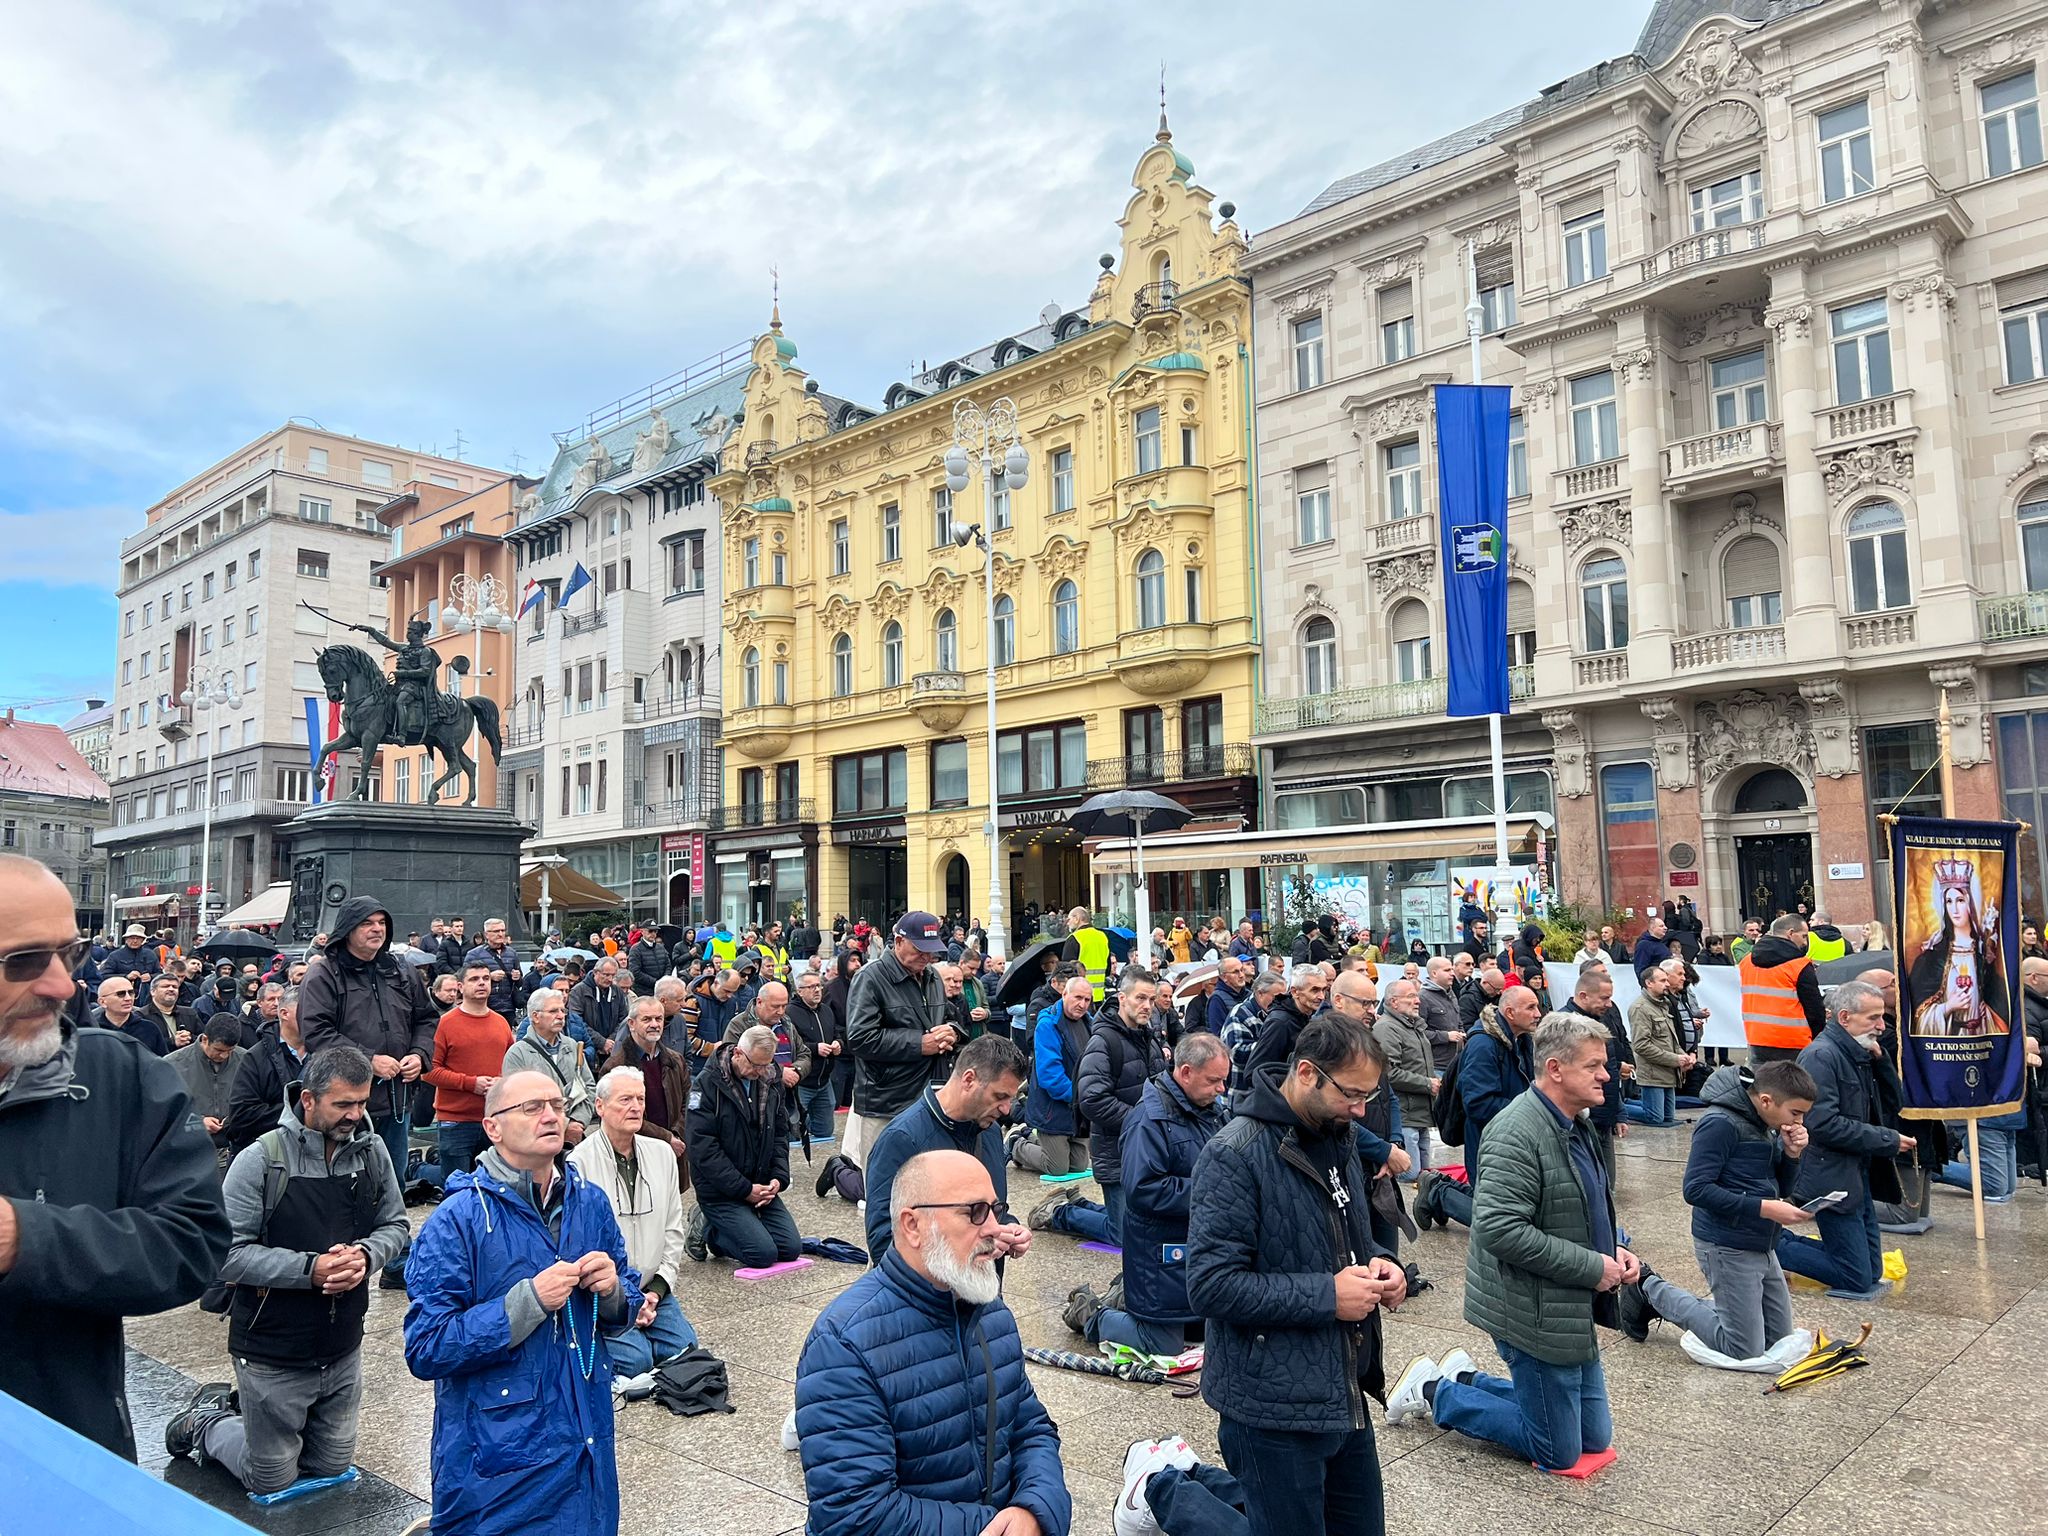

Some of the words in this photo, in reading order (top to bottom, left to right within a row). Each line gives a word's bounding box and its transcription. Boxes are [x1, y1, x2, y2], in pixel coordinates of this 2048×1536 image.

[1015, 810, 1068, 826] HARMICA
[850, 827, 892, 841] HARMICA
[1260, 853, 1308, 864] RAFINERIJA
[1925, 1042, 1958, 1050] SLATKO
[1933, 1053, 1954, 1061] BUDI
